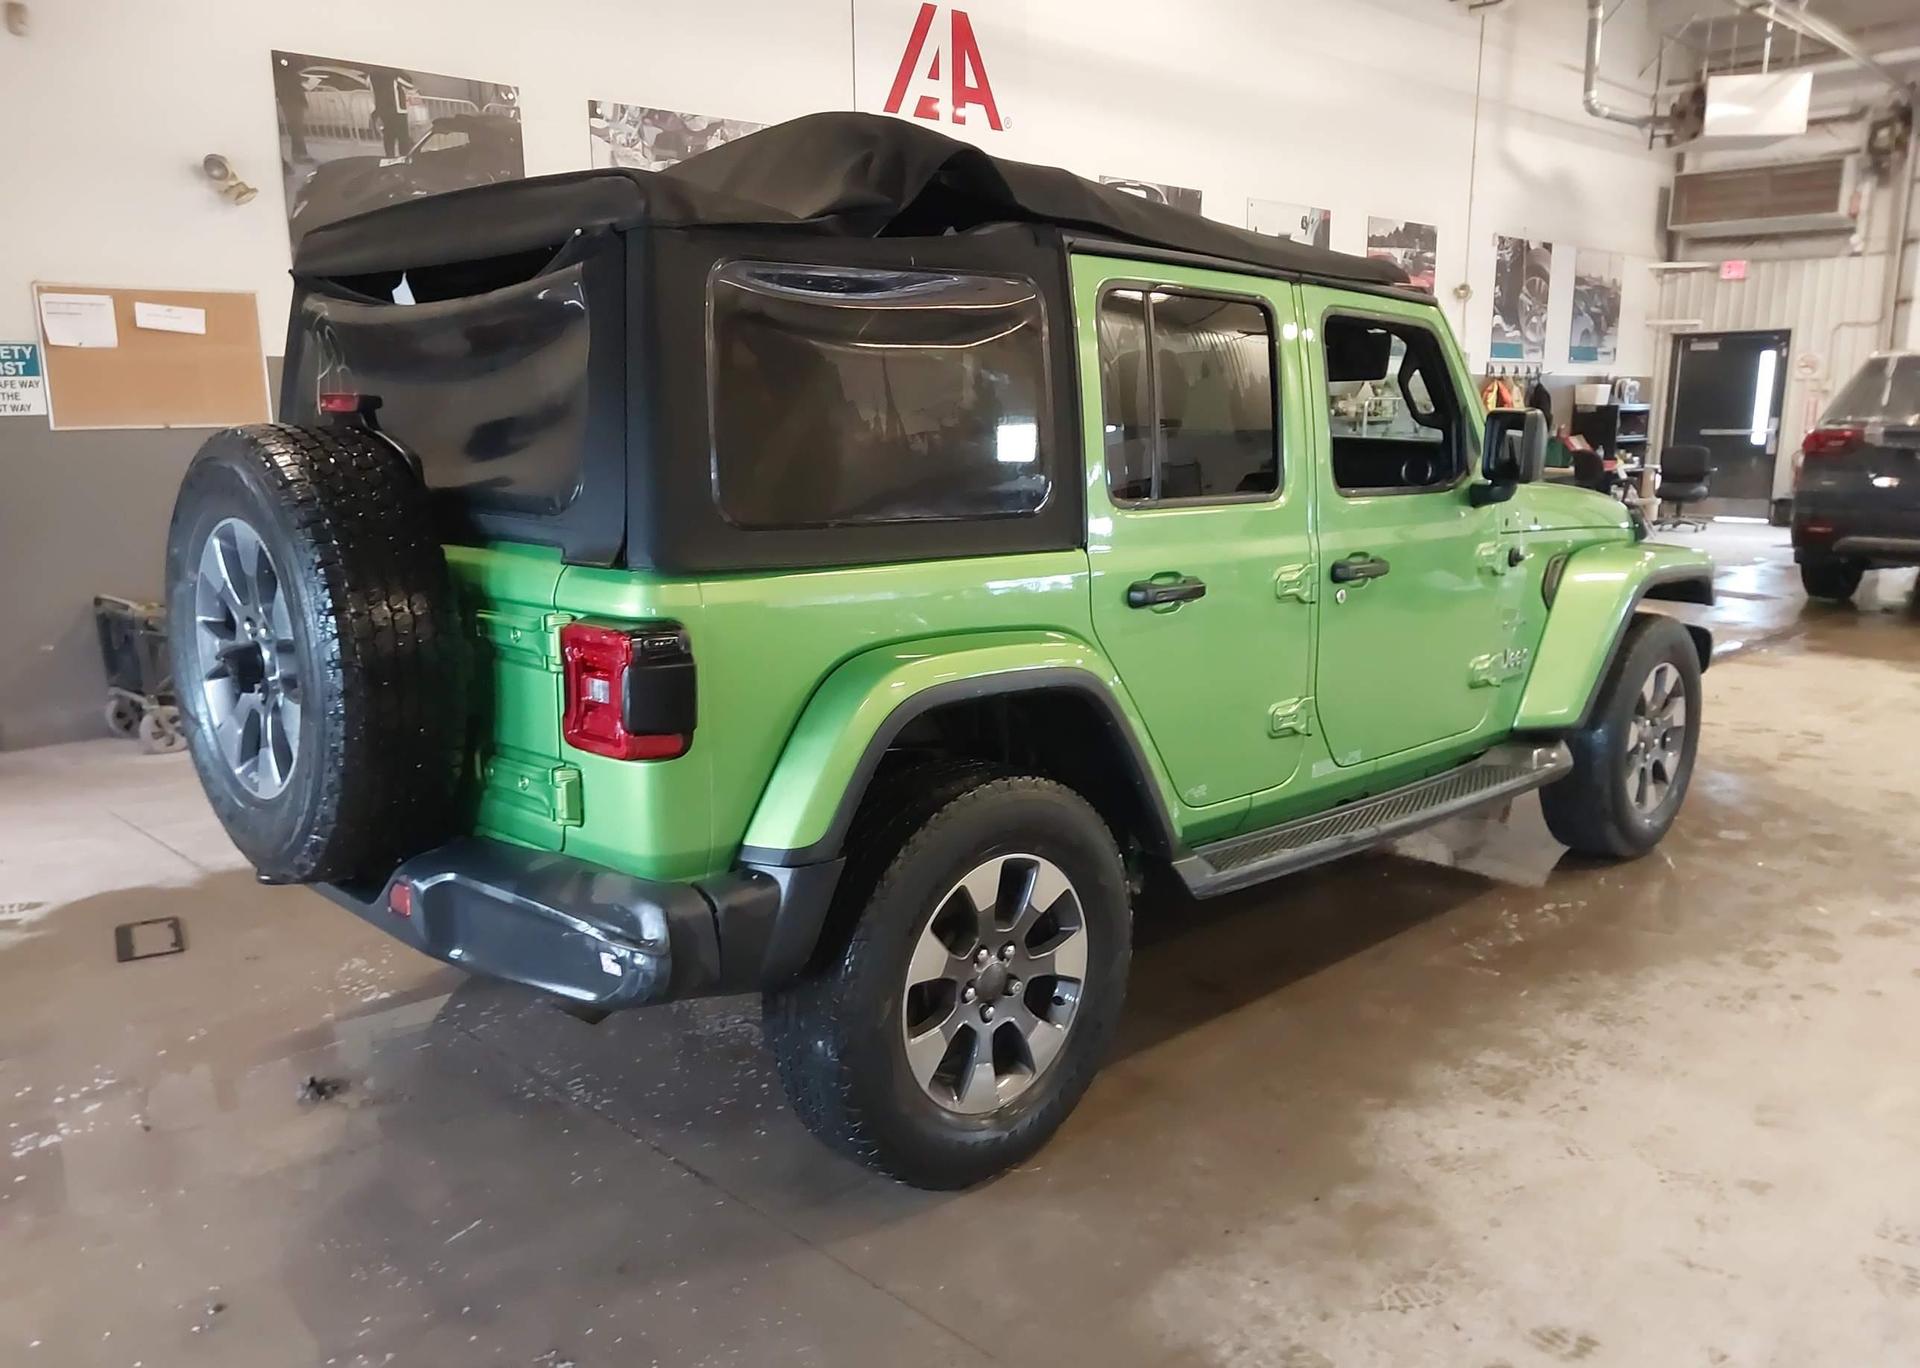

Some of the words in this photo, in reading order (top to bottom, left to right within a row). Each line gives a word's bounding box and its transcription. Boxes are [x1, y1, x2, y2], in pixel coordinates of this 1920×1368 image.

[18, 379, 40, 389] WAY
[1, 392, 21, 401] THE
[10, 403, 31, 412] WAY
[1503, 648, 1528, 669] Jeep
